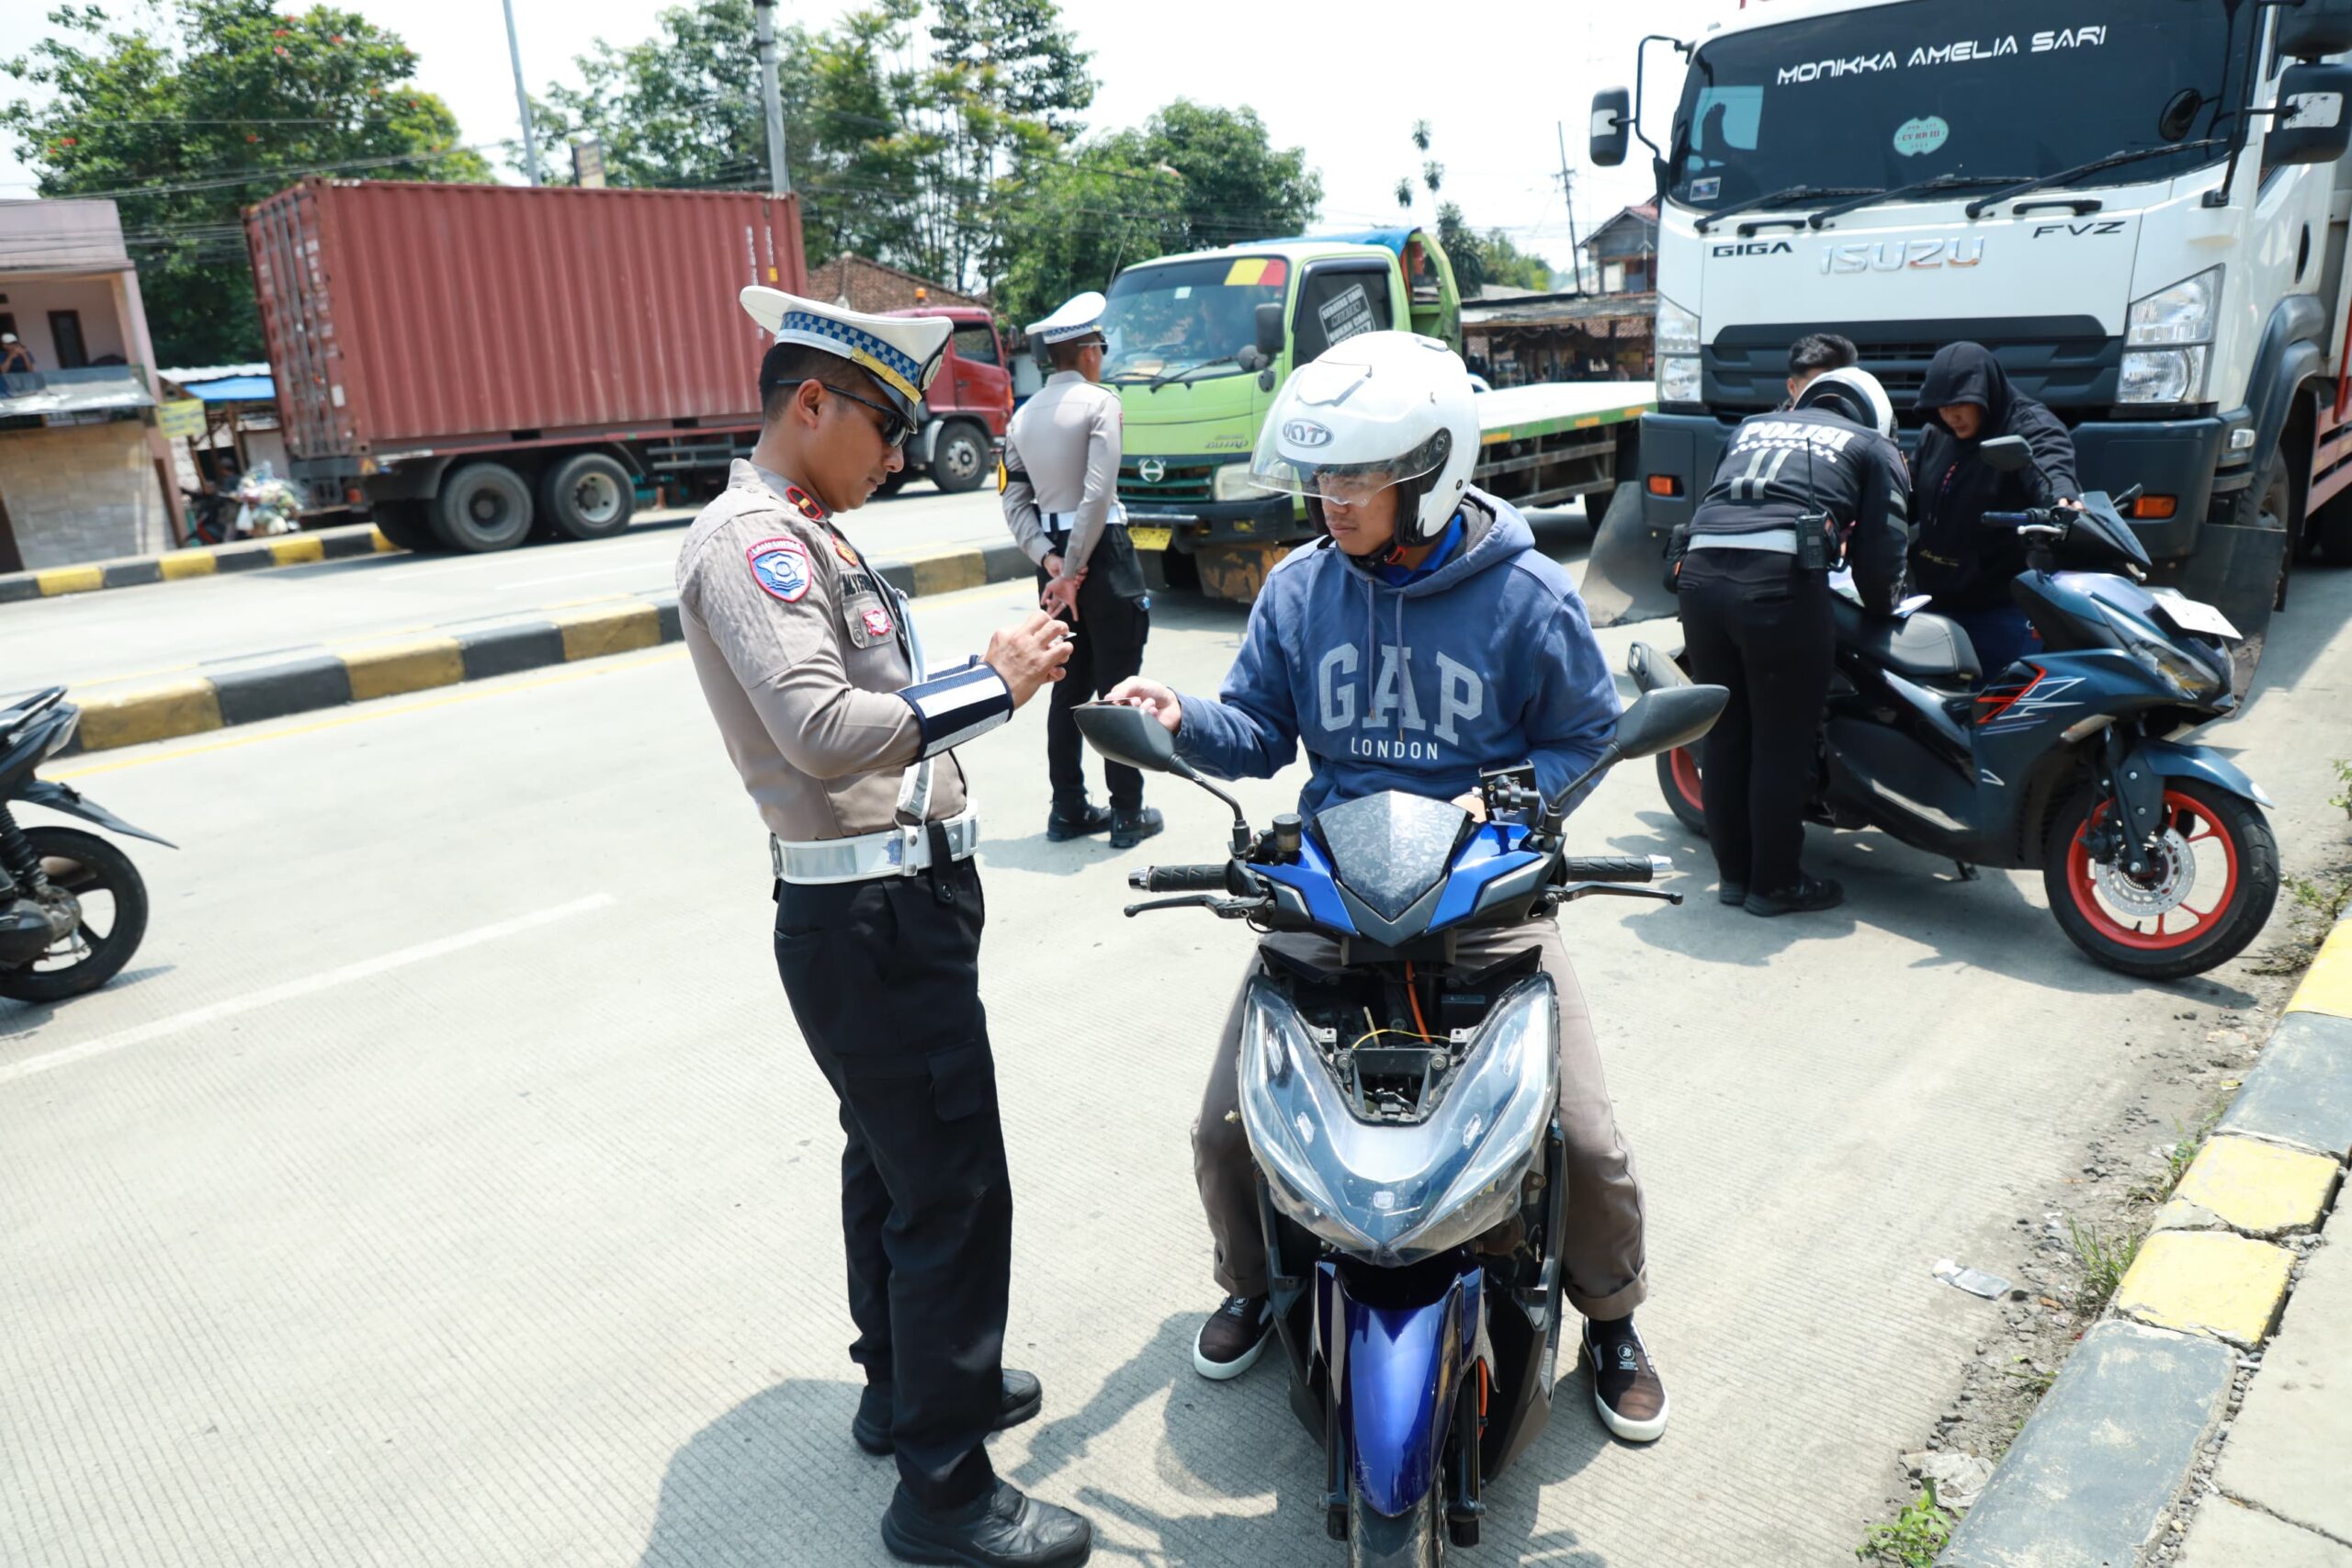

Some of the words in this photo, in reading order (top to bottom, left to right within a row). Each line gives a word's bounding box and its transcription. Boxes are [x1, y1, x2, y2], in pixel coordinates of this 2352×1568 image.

[1777, 51, 1897, 85] MONIKKA
[1907, 35, 2018, 68] AMELIA
[2030, 25, 2107, 52] SARI
[2032, 221, 2127, 239] FVZ
[1712, 242, 1793, 257] GIGA
[1819, 235, 1984, 276] ISUZU
[1286, 423, 1326, 444] KYT
[1736, 421, 1855, 453] POLISI
[1318, 642, 1484, 747] GAP
[1351, 737, 1439, 761] LONDON
